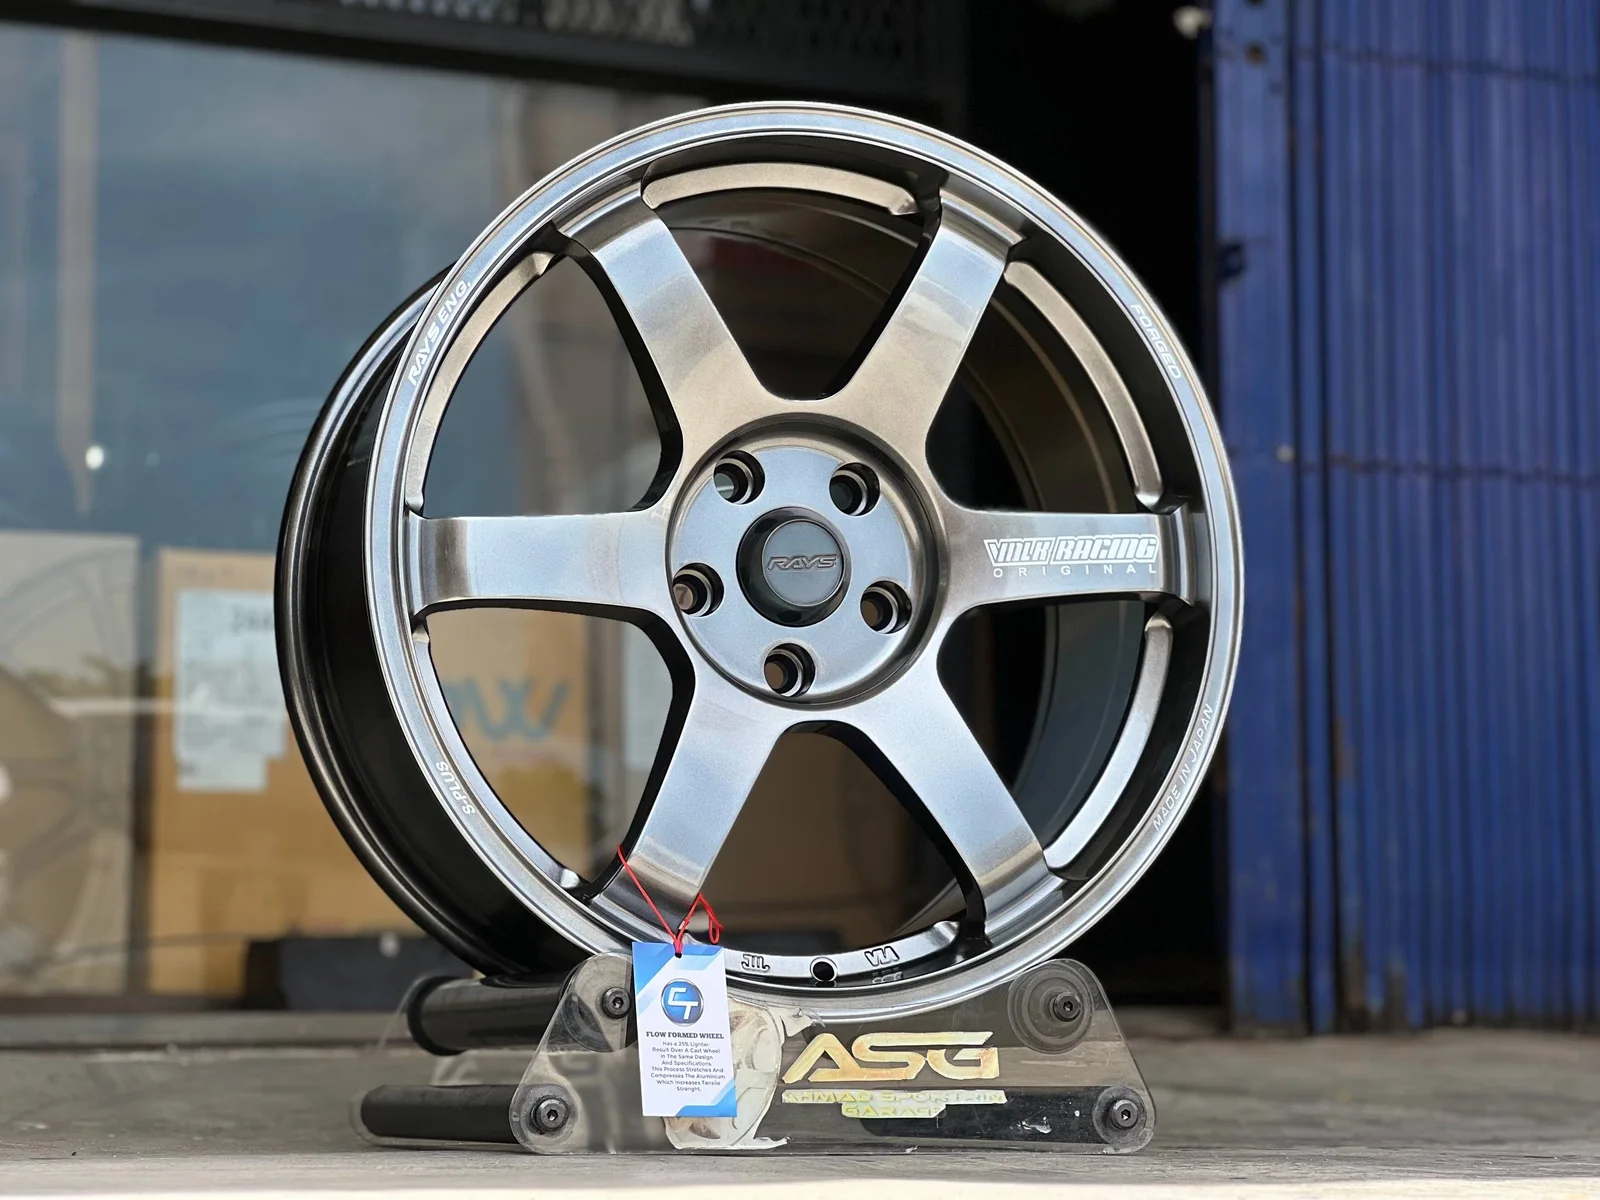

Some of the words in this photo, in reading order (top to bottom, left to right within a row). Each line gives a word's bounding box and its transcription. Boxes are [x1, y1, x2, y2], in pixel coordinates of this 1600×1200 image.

[408, 322, 440, 386] RAYS
[437, 280, 471, 324] ENG.
[1130, 304, 1181, 379] FORGED
[767, 554, 838, 571] RAYS
[984, 537, 1055, 566] VOLK
[1051, 534, 1160, 564] RACING
[993, 564, 1157, 578] ORIGINAL
[435, 761, 476, 815] S-PLUS
[1153, 785, 1181, 832] MADE
[1179, 763, 1191, 784] IN
[1189, 703, 1213, 762] JAPAN
[782, 1031, 999, 1084] ASG
